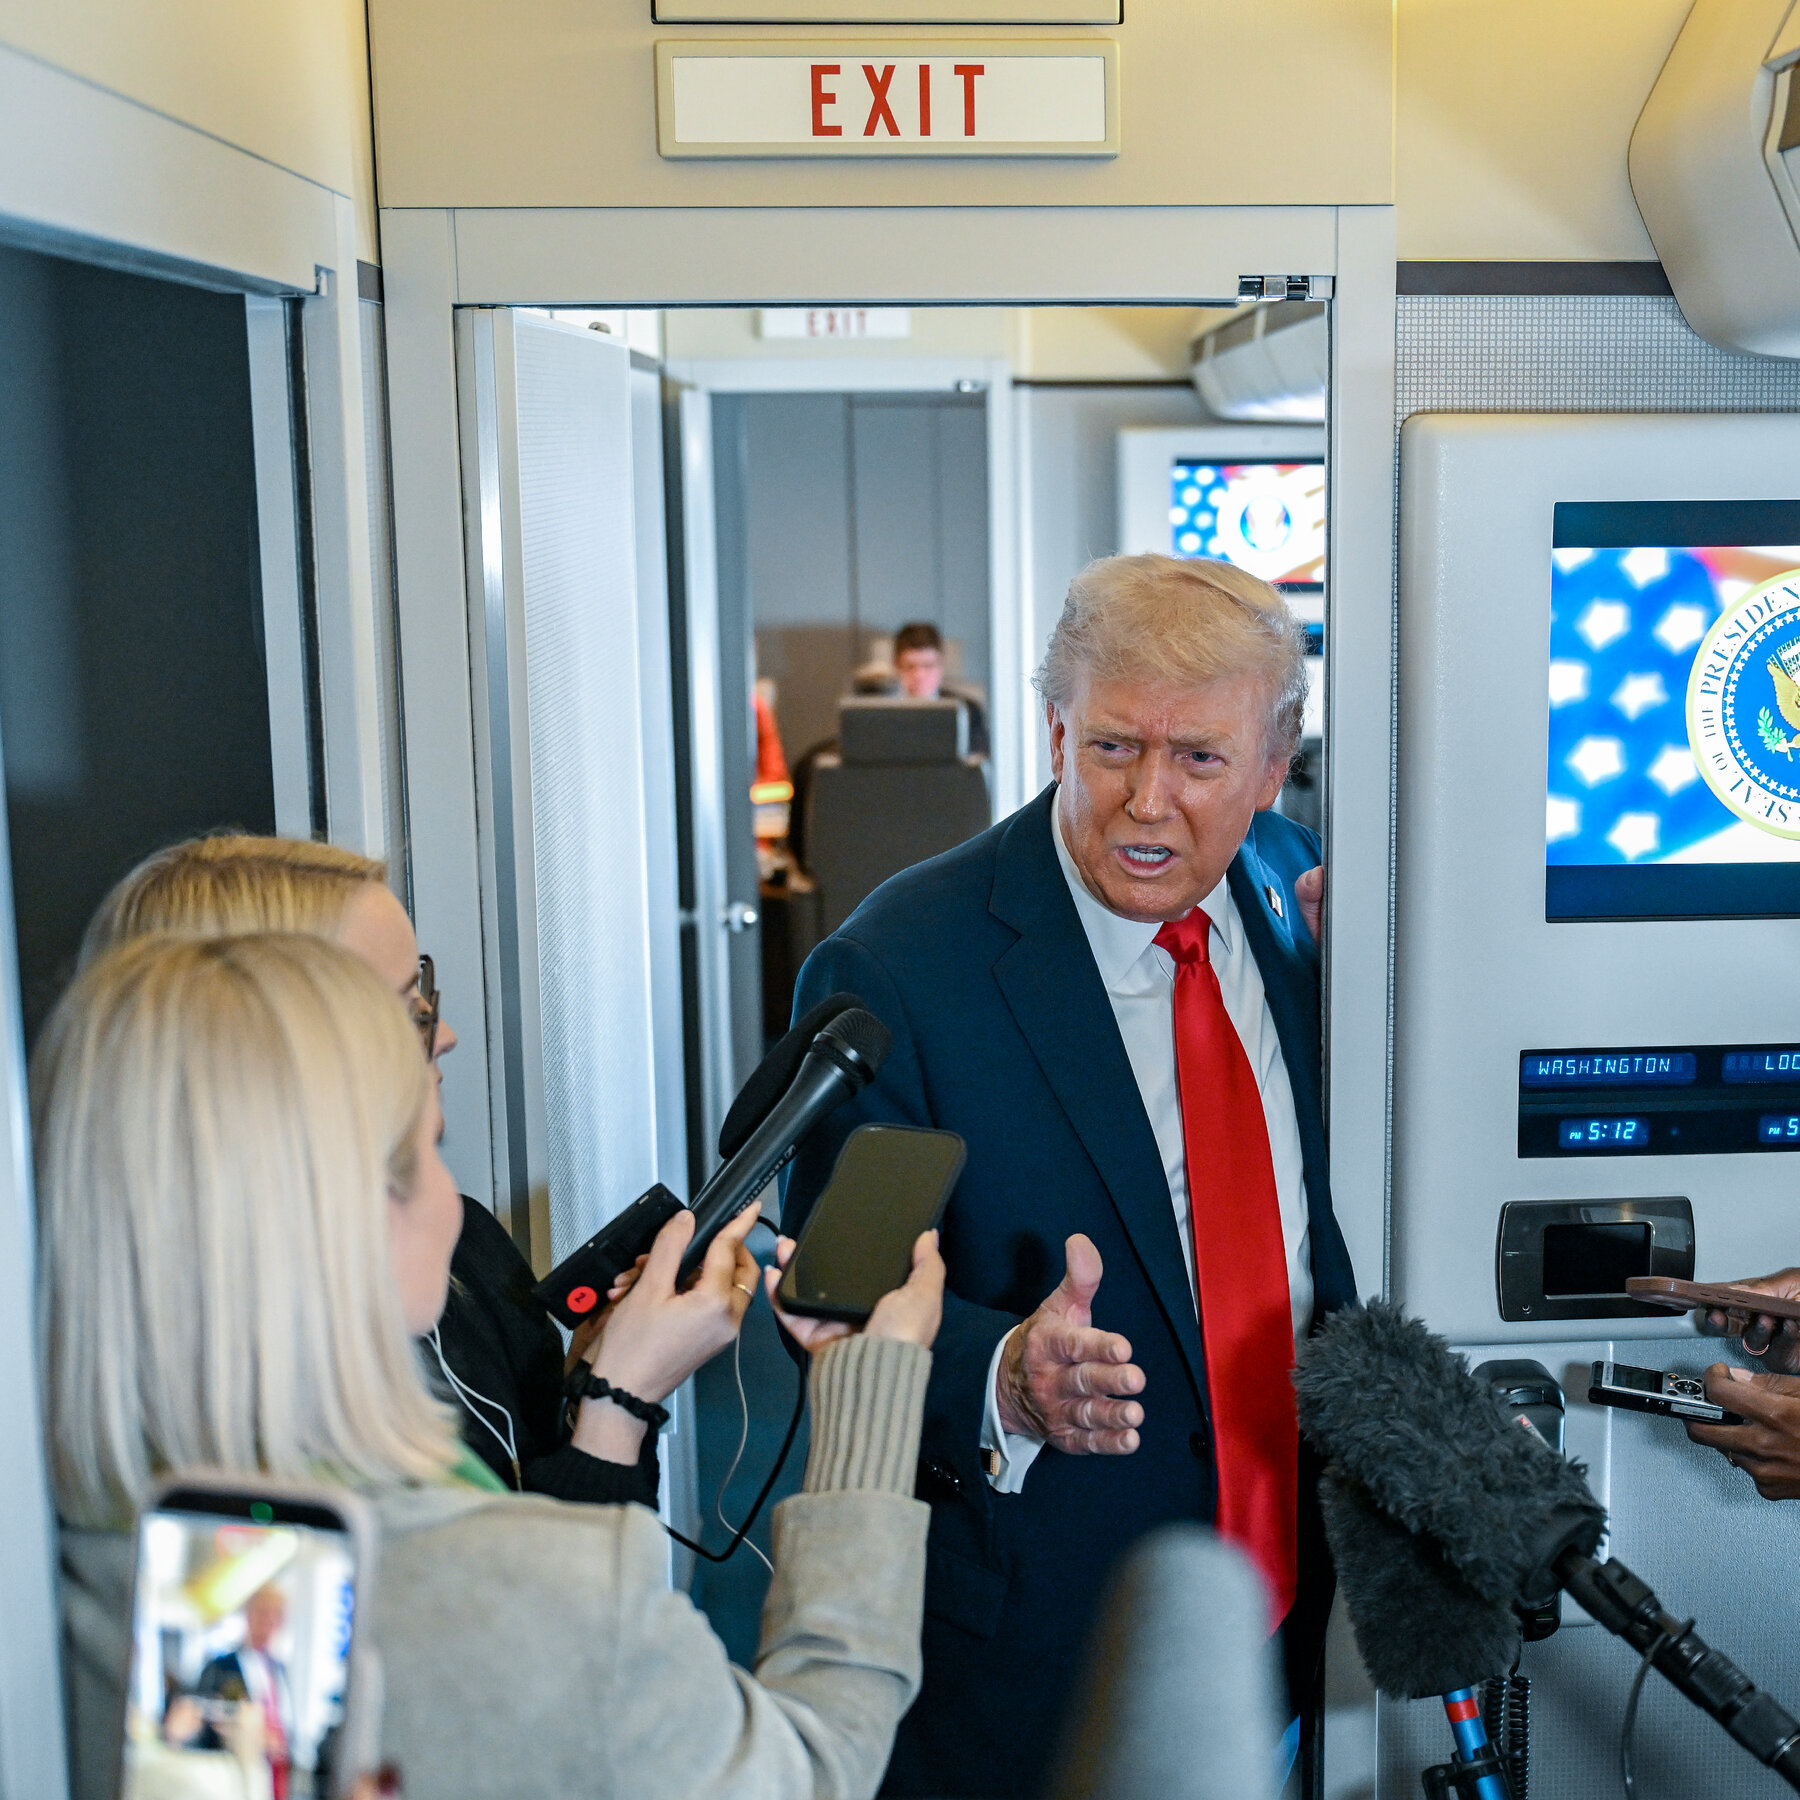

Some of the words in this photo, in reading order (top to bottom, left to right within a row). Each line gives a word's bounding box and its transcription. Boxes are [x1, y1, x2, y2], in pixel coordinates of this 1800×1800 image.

[810, 64, 985, 137] EXIT
[806, 308, 867, 337] EXIT
[1538, 1058, 1670, 1075] WASHINGTON
[1569, 1131, 1582, 1140] PM
[1588, 1122, 1636, 1140] 5:12
[1768, 1127, 1781, 1135] PM
